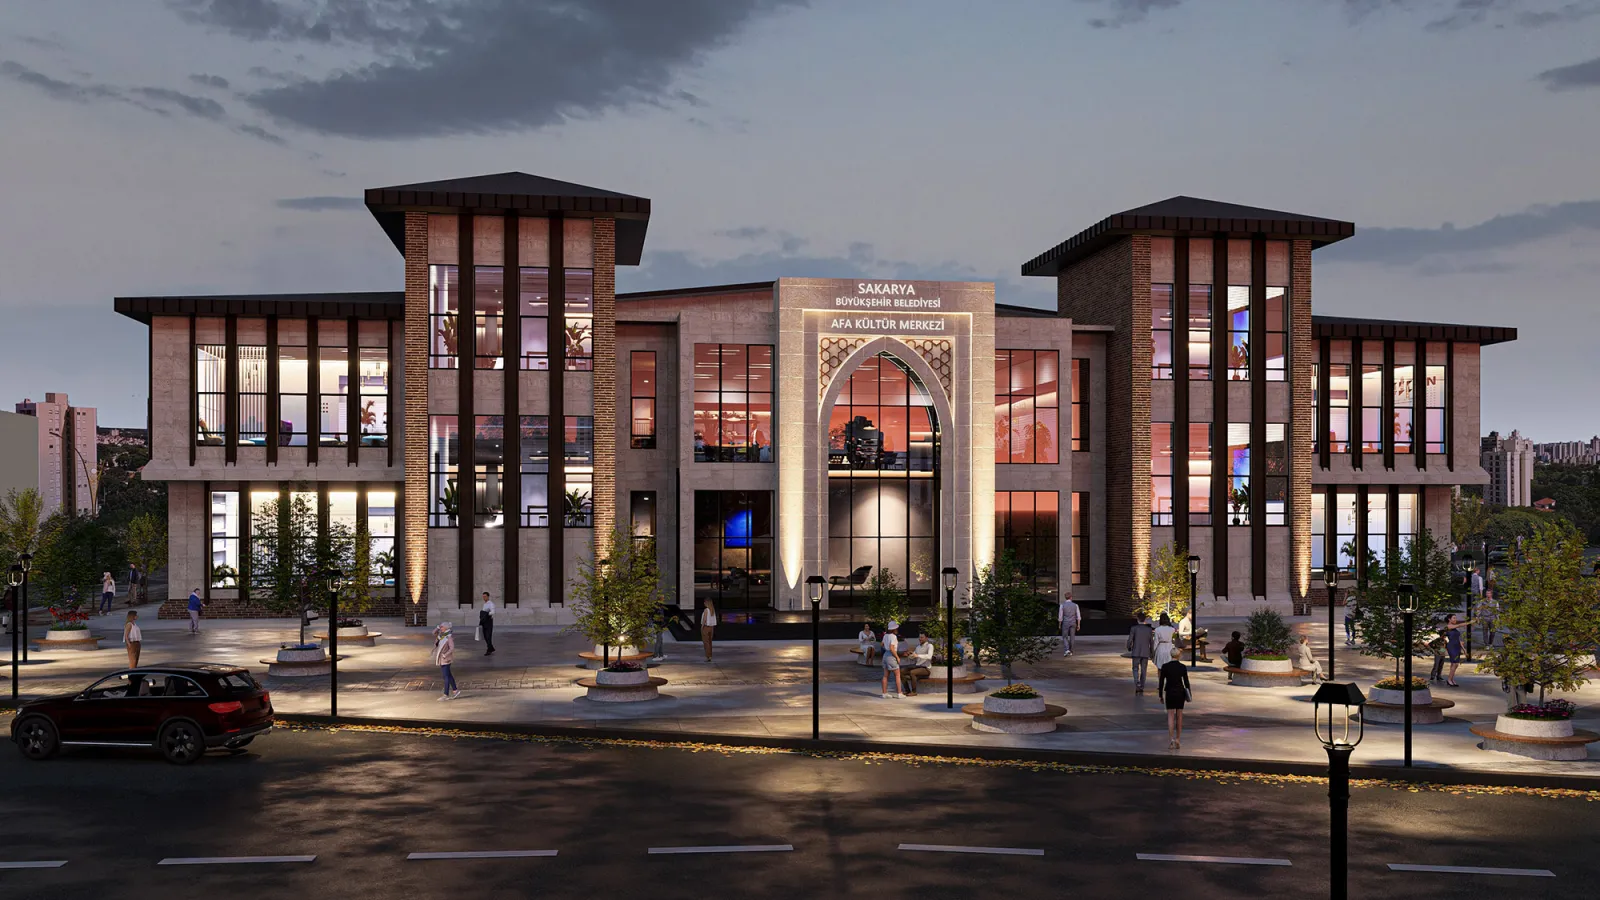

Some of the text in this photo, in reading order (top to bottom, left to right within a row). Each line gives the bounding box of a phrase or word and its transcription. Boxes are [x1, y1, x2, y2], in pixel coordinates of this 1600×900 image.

[858, 282, 915, 295] SAKARYA
[835, 296, 941, 308] BÜYÜKŞEHİR BELEDİYESİ
[831, 317, 945, 331] AFA KÜLTÜR MERKEZİ
